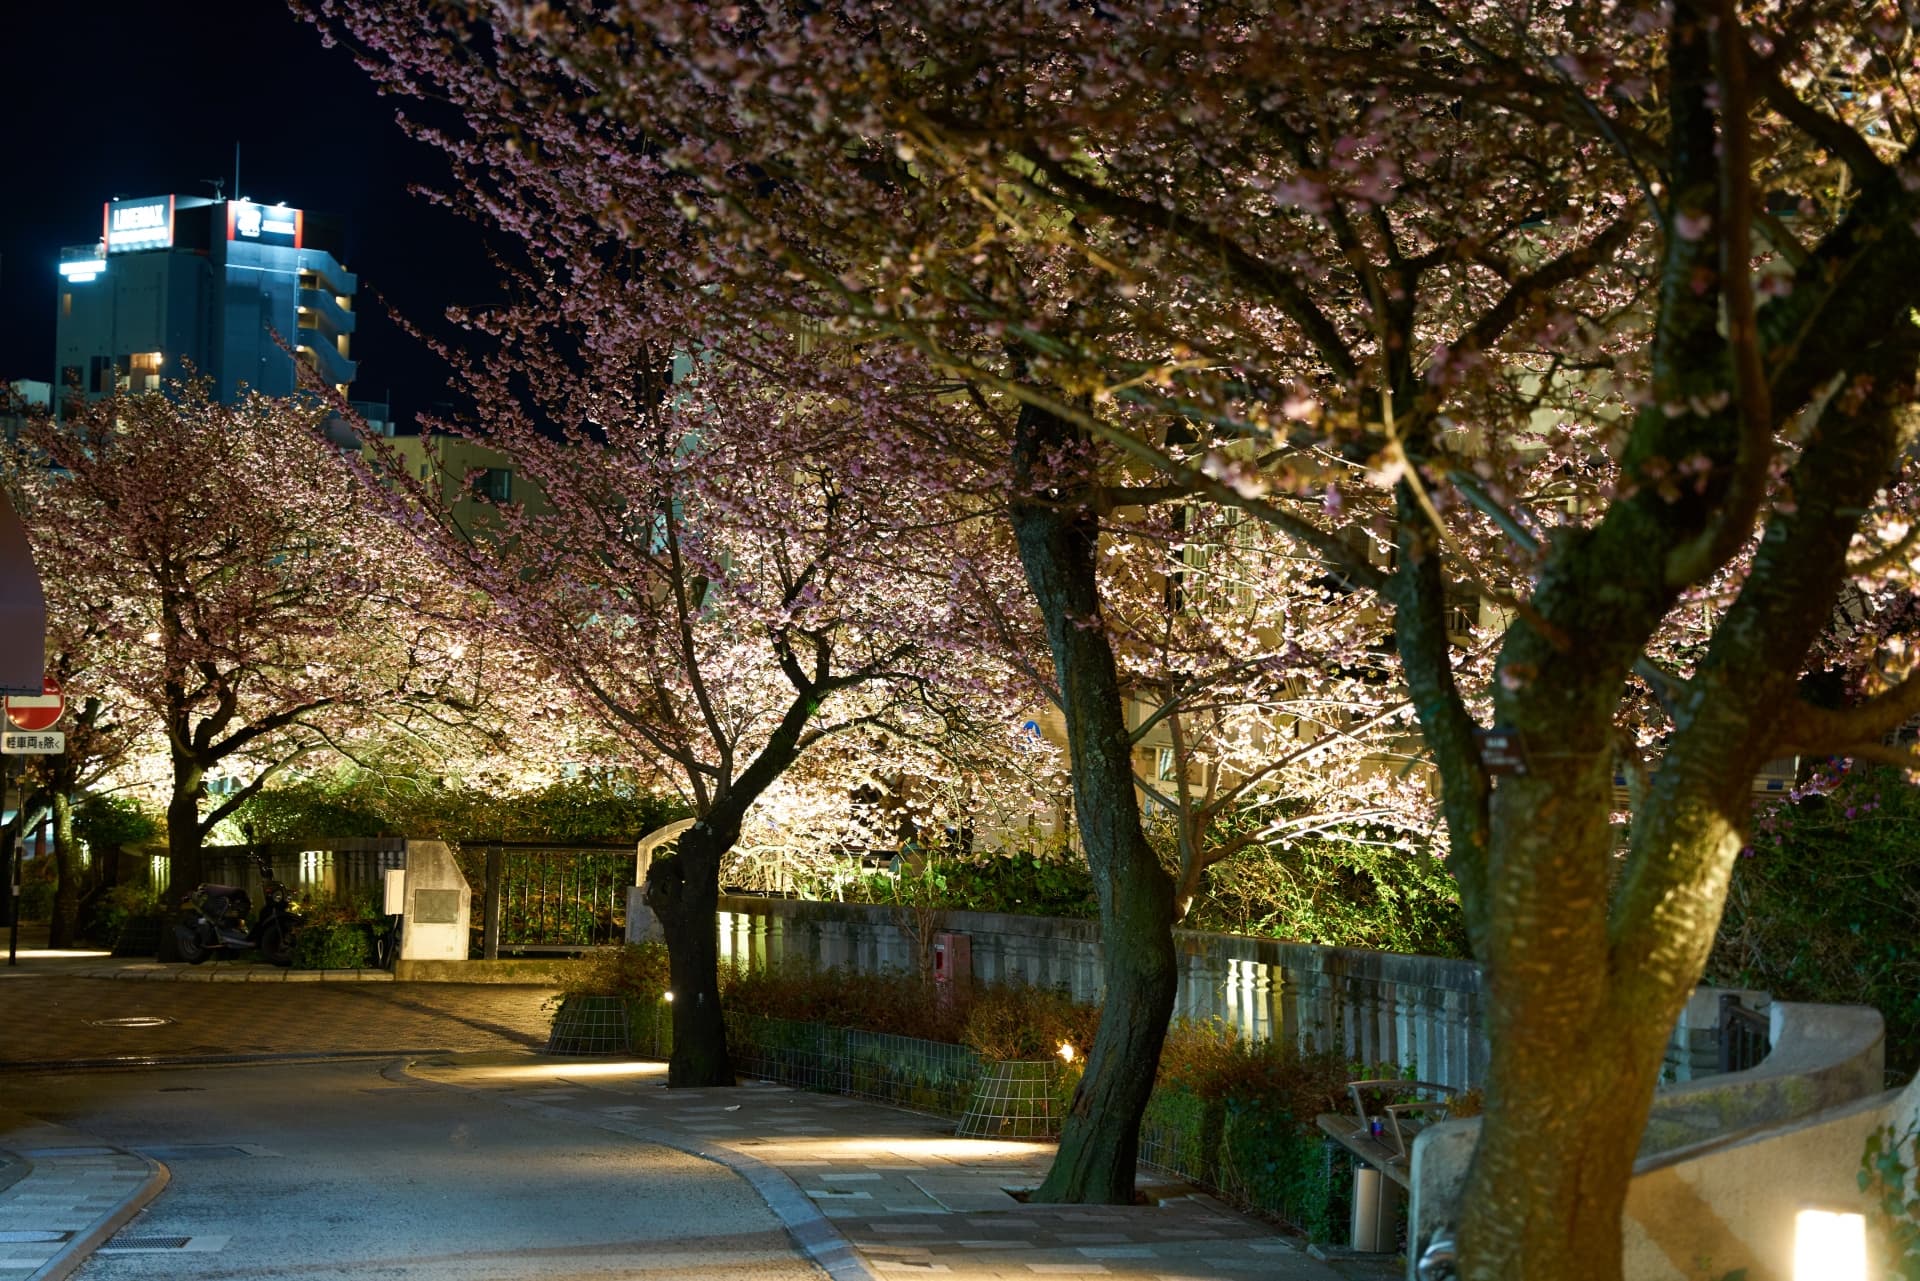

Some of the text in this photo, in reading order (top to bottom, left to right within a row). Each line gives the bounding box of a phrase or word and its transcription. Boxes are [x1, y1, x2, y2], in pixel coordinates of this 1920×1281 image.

[6, 736, 60, 749] 軽車両を除く
